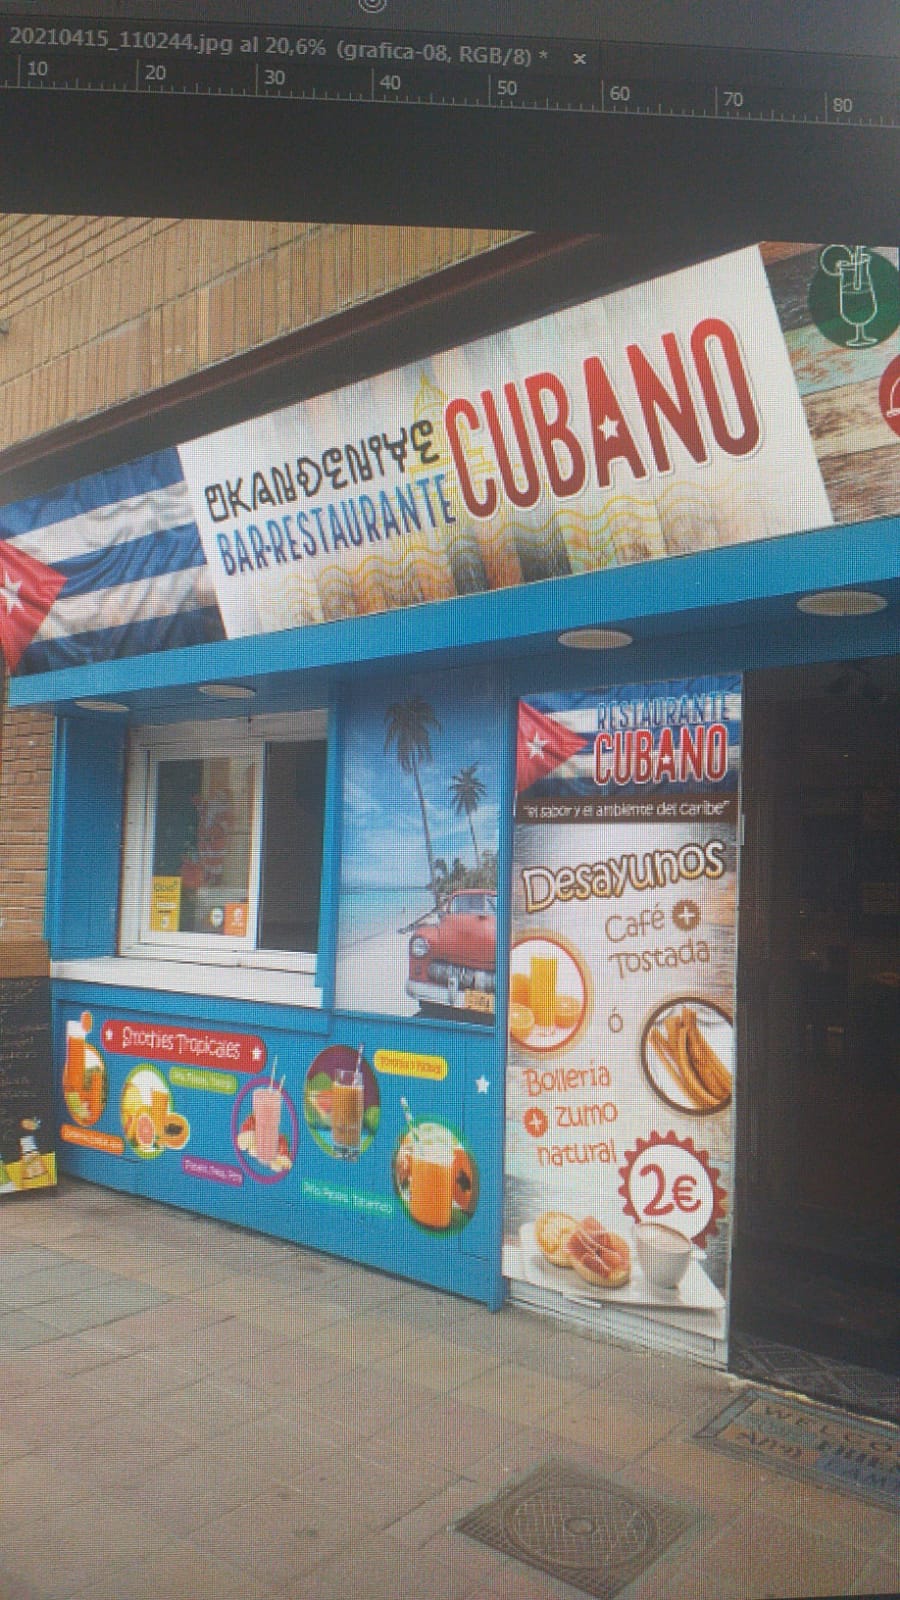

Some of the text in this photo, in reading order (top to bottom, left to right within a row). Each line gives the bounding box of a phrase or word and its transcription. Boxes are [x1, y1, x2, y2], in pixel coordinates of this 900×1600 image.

[9, 27, 233, 55] 20210415_110244.jpg
[240, 36, 259, 54] al
[266, 37, 327, 57] 20,6%
[459, 46, 532, 67] RGB/8)
[28, 61, 853, 113] 10 20 30 40 50 60 70 80
[444, 317, 762, 519] CUBANO
[216, 473, 457, 576] BAR-RESTAURANTE
[597, 691, 732, 730] RESTAURANTE
[593, 723, 729, 786] CUBANO
[541, 803, 572, 818] sabor
[582, 804, 593, 818] el
[596, 802, 653, 817] ambiente
[656, 802, 677, 816] del
[522, 839, 726, 914] Desayunos
[604, 904, 665, 943] Café
[608, 938, 711, 979] Tostada
[175, 1033, 241, 1060] Tropicales
[556, 1102, 618, 1128] zumo
[537, 1141, 617, 1167] natural
[639, 1163, 702, 1216] 2€
